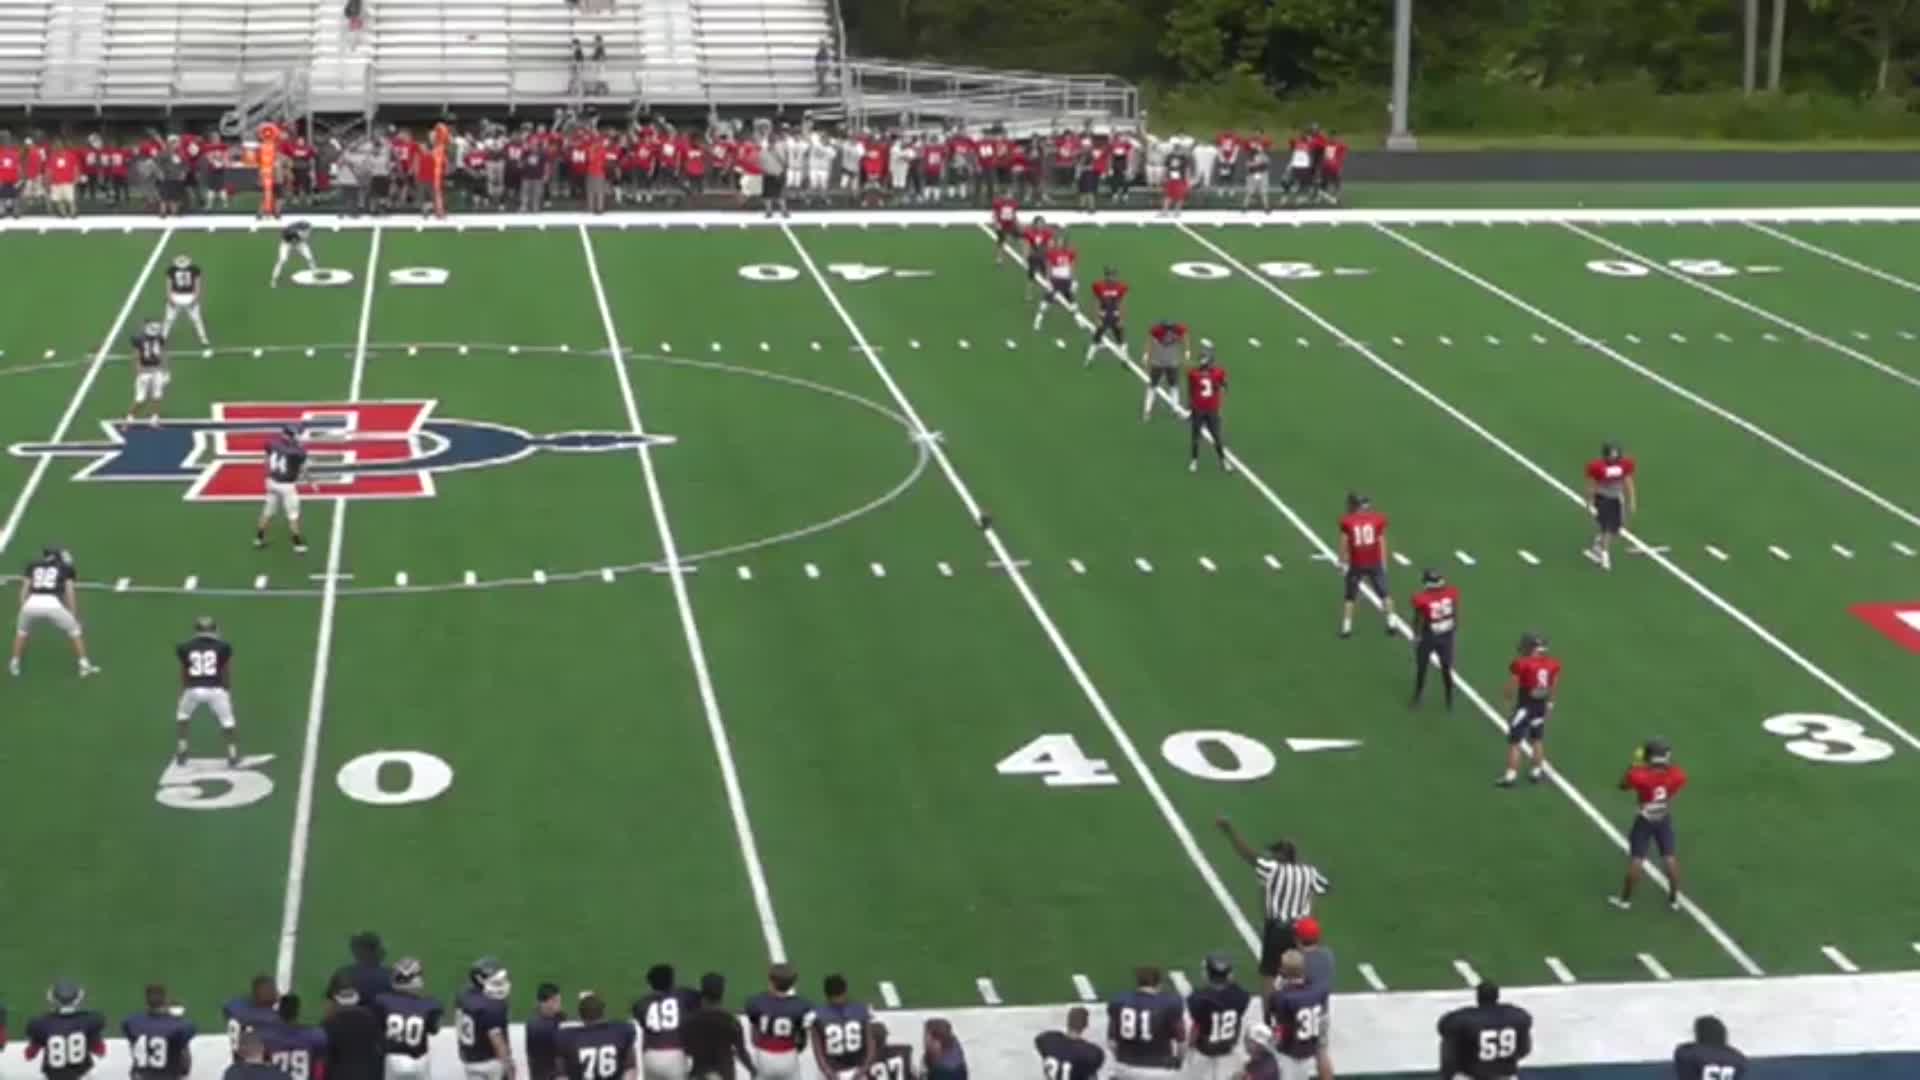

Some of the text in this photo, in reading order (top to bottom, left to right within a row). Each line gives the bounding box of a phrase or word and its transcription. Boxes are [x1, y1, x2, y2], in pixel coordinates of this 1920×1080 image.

[189, 650, 218, 677] 32
[645, 998, 680, 1032] 49
[1119, 1007, 1153, 1041] 81
[1208, 1009, 1239, 1043] 12
[47, 1032, 87, 1068] 88
[131, 1034, 168, 1068] 43
[824, 1019, 862, 1055] 26
[1478, 1027, 1517, 1061] 59
[578, 1045, 617, 1080] 76
